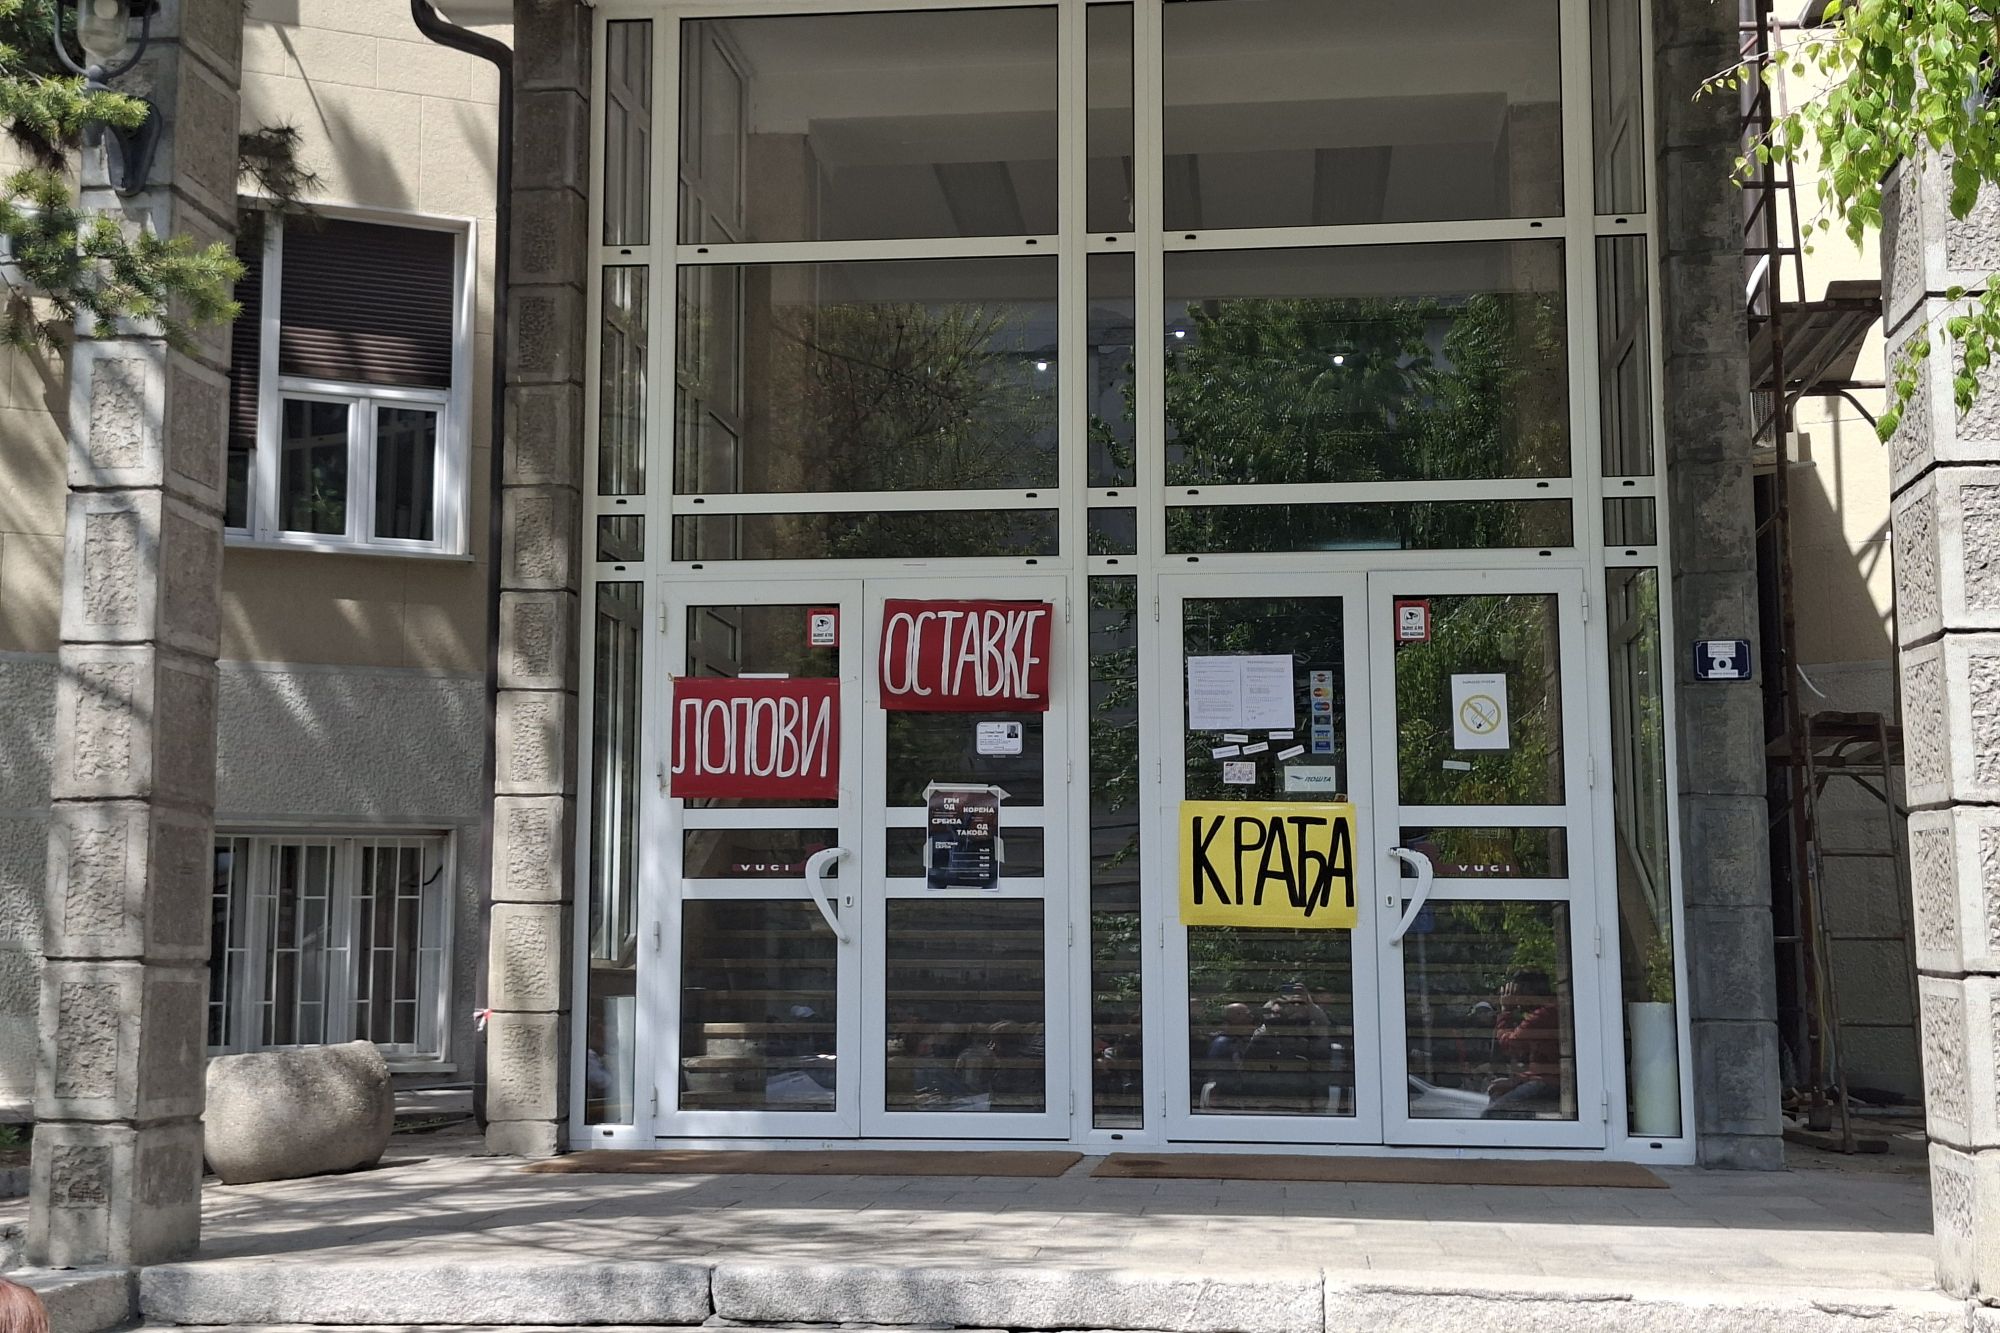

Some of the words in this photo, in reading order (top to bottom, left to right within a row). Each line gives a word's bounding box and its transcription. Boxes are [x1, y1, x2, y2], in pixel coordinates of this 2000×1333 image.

[883, 610, 1046, 699] ОСТАВКЕ
[671, 696, 831, 778] ЛОПОВИ
[1191, 814, 1355, 917] КРАЂА
[1458, 864, 1510, 872] VUCI
